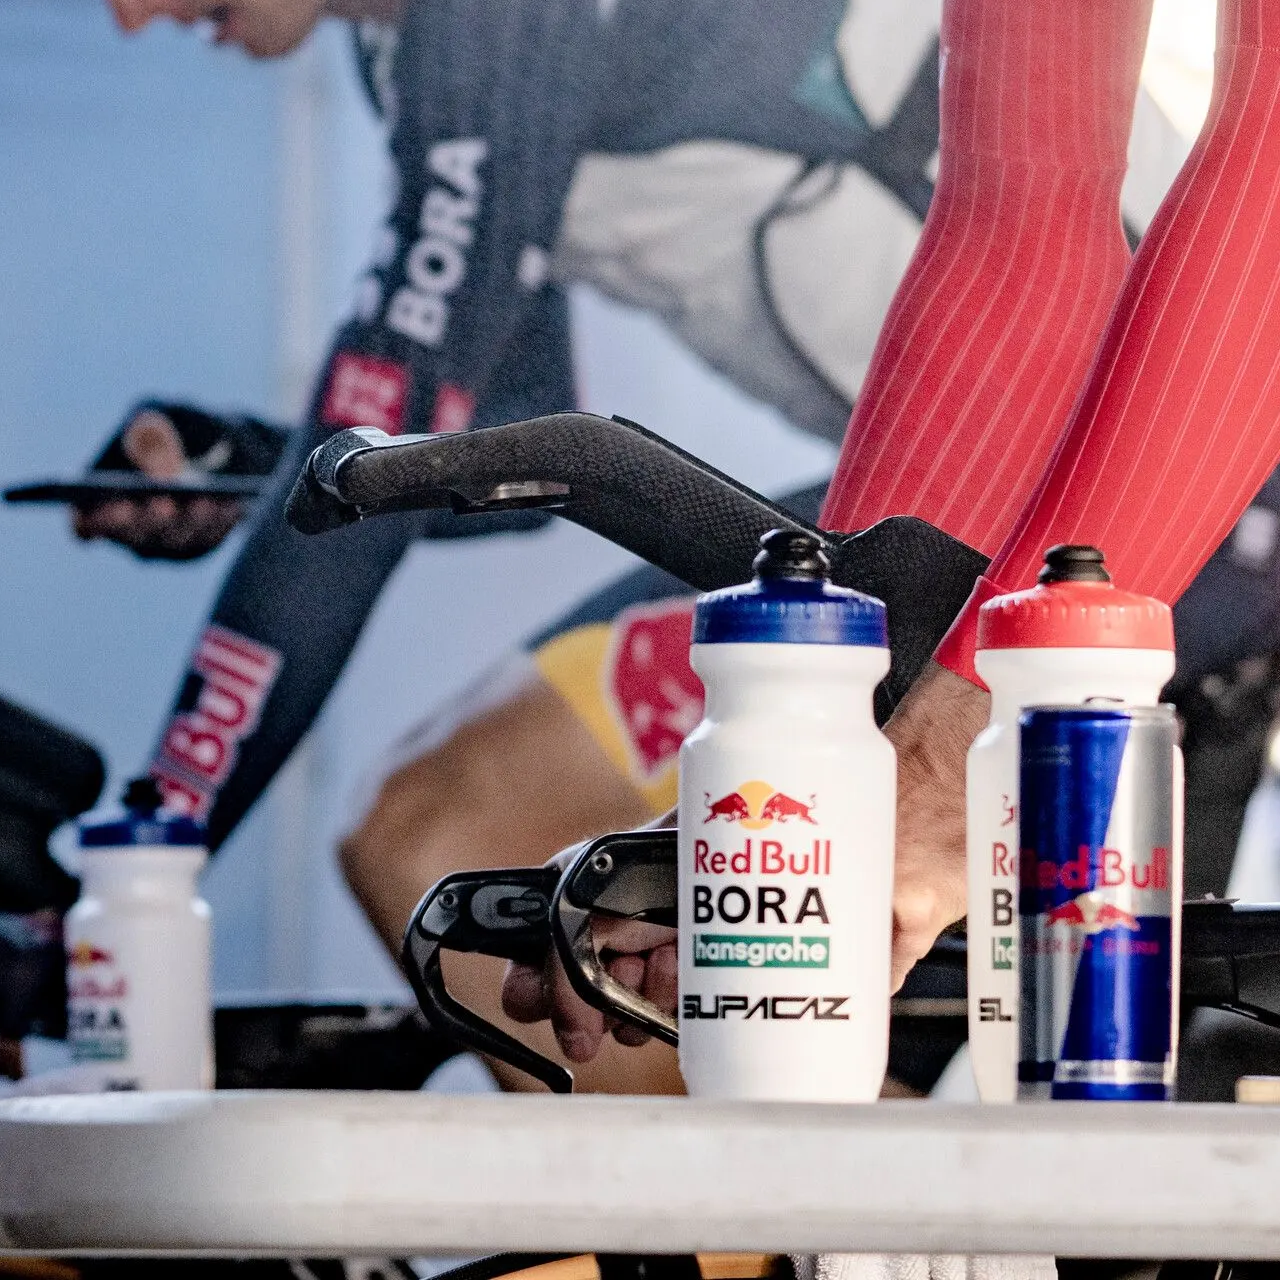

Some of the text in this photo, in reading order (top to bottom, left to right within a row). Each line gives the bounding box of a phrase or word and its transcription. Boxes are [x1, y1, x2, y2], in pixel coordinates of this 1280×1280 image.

[384, 137, 488, 346] BORA
[162, 626, 277, 782] Bull
[694, 838, 831, 875] Red Bull
[1098, 846, 1169, 891] Bull
[693, 885, 830, 925] BORA
[695, 934, 827, 967] hansgrohe
[682, 994, 851, 1021] SUPACAZ
